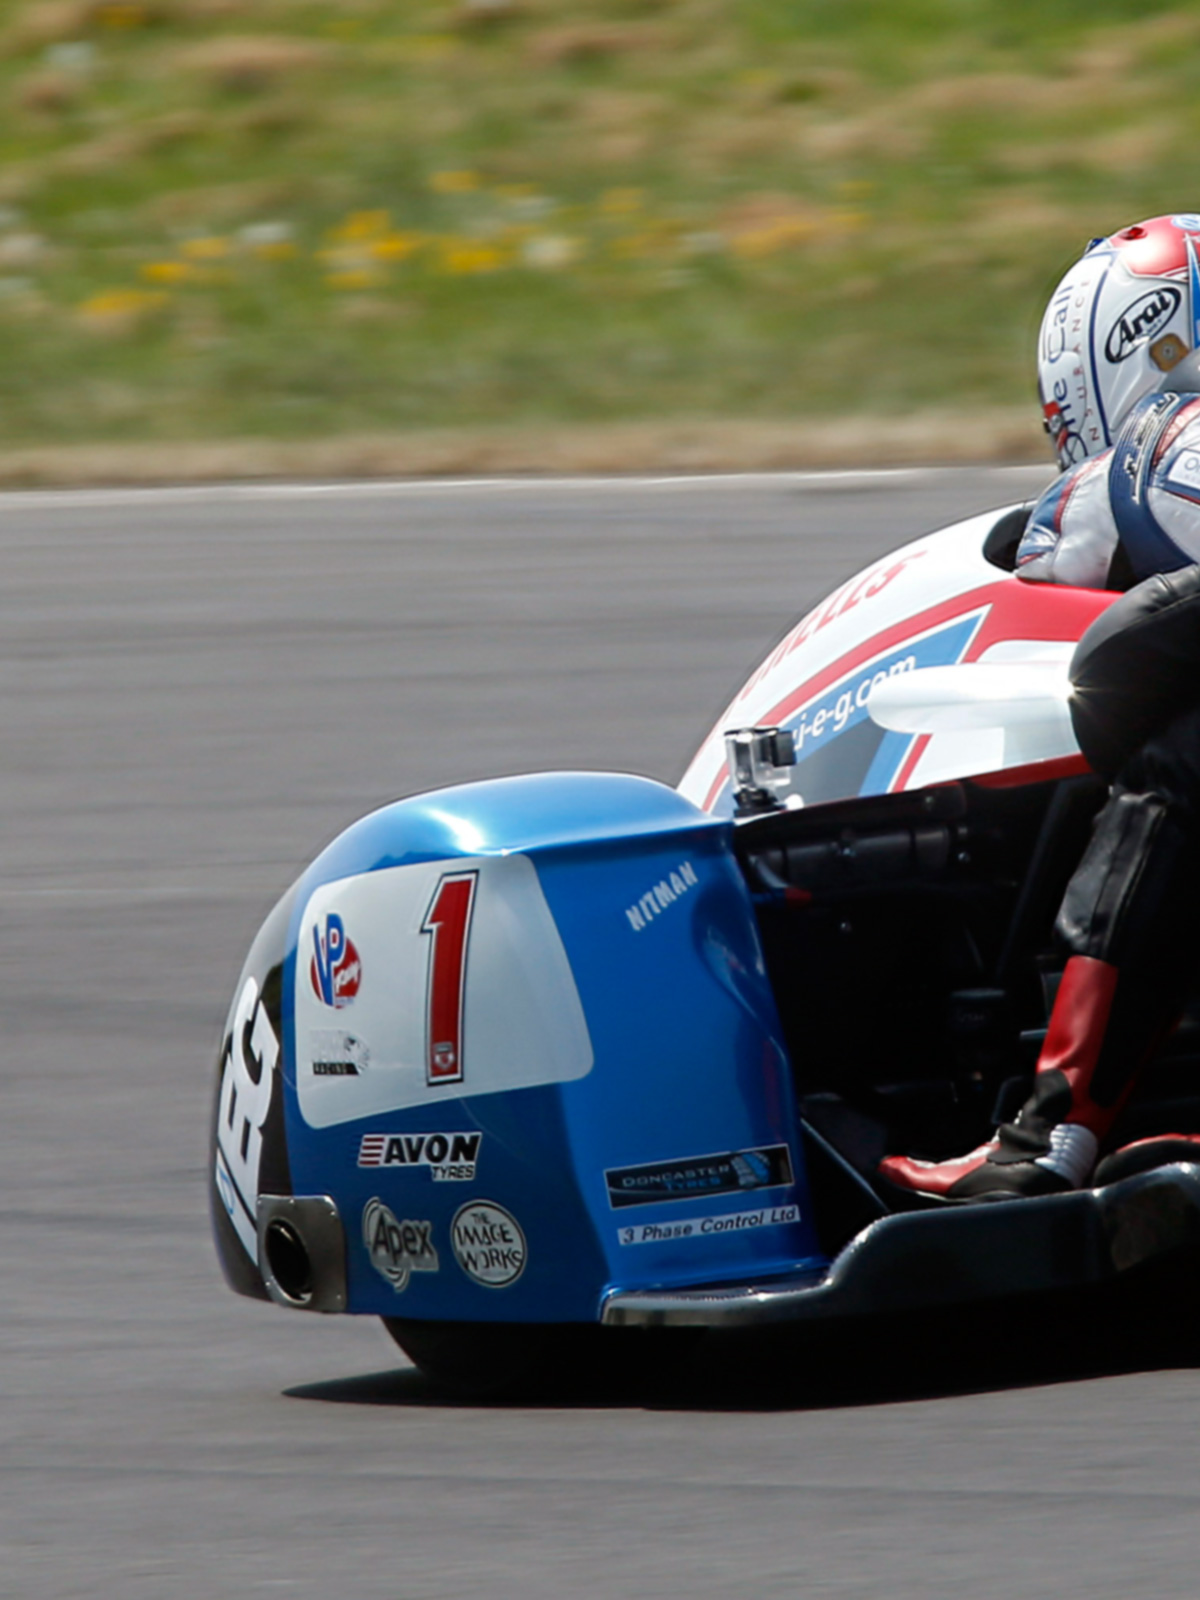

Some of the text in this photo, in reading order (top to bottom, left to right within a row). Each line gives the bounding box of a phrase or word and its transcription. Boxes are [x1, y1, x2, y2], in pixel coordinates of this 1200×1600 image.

[1047, 284, 1074, 364] Call
[1112, 289, 1172, 352] Arai
[312, 913, 346, 1007] VP
[420, 869, 479, 1086] 1
[383, 1133, 481, 1164] AVON
[431, 1164, 475, 1180] TYRES
[621, 1164, 731, 1188] DONCASTER
[456, 1222, 514, 1248] IMAGE
[470, 1211, 489, 1225] THE
[623, 1207, 797, 1244] 3 Phase Control Ltd
[371, 1211, 434, 1265] Apex
[461, 1247, 523, 1272] WORKS
